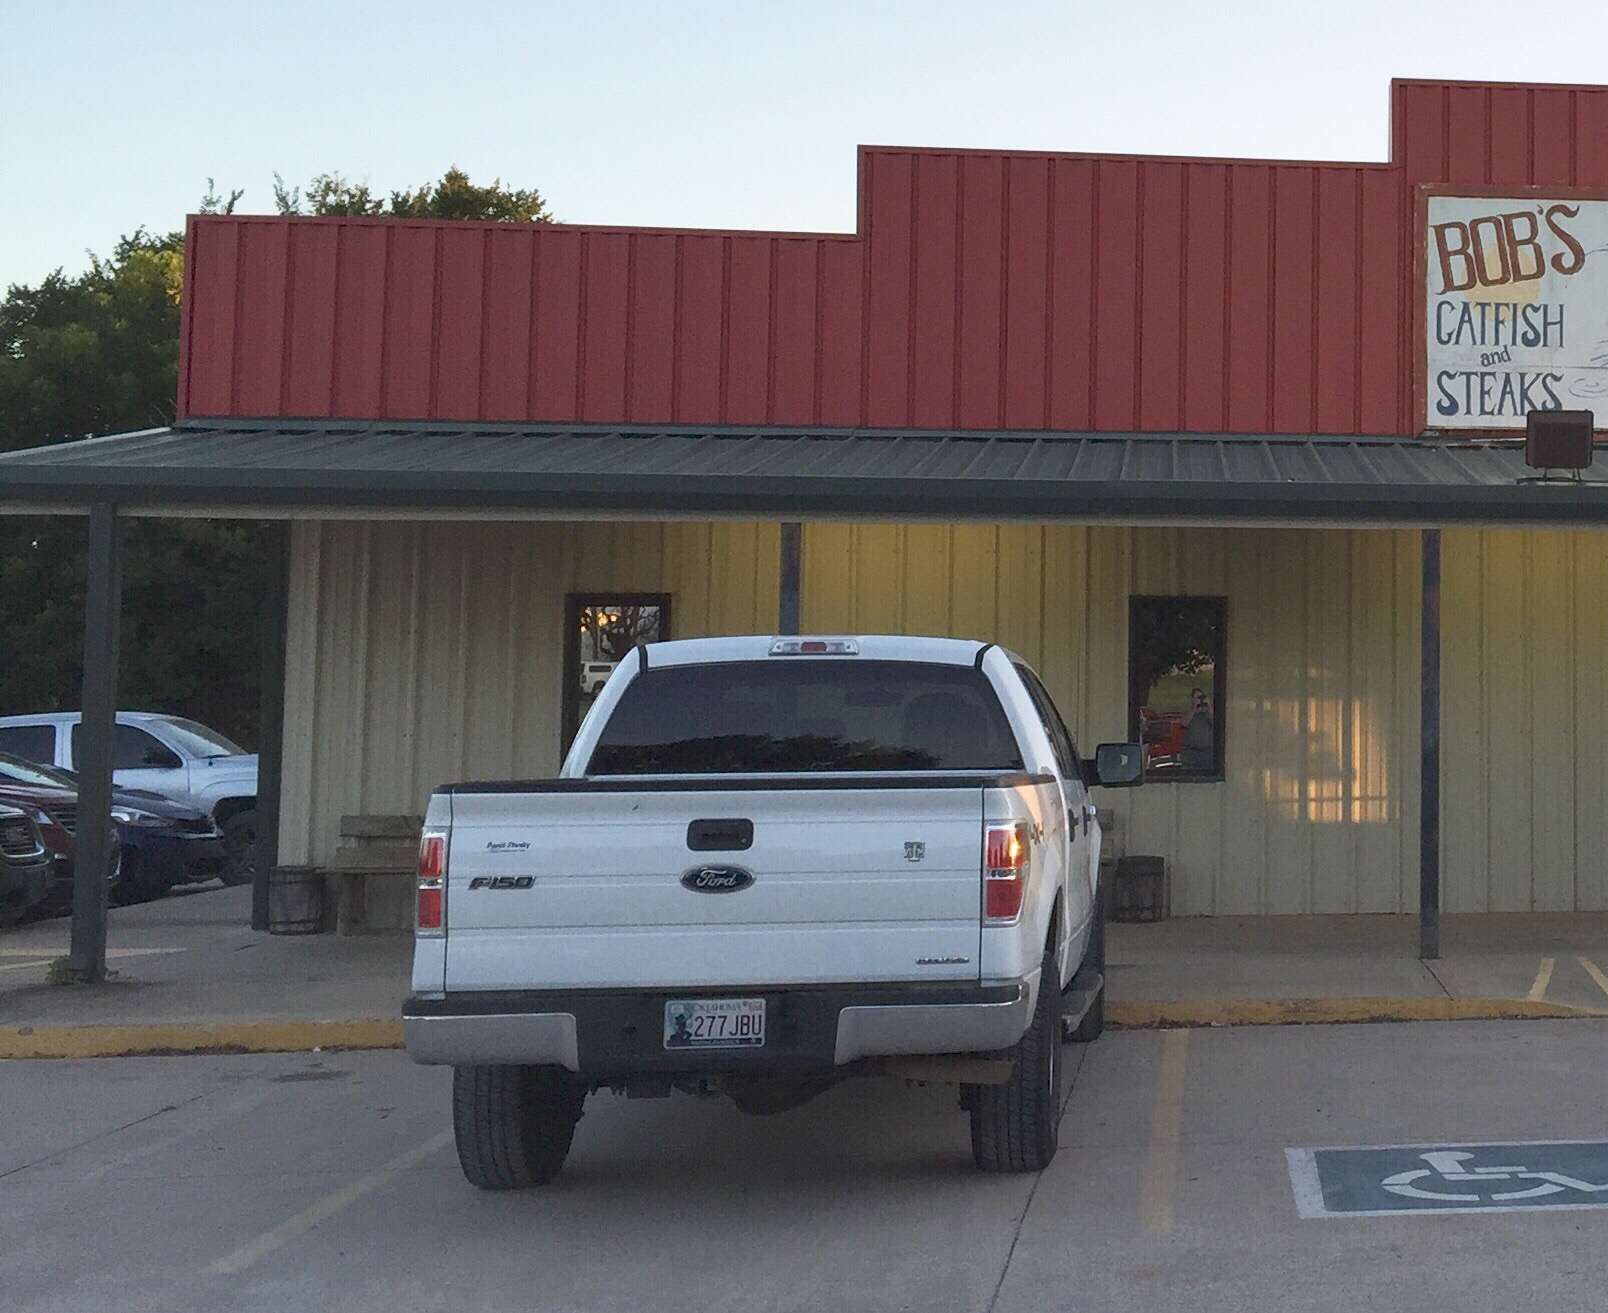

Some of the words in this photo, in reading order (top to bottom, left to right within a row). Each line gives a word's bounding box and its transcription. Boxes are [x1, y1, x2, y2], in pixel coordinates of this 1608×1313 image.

[1430, 204, 1585, 295] BOB'S
[1436, 300, 1565, 348] CATFISH
[1480, 344, 1512, 367] and
[1436, 370, 1565, 417] STEAKS
[696, 868, 738, 887] Ford
[694, 1013, 763, 1038] 277JBU
